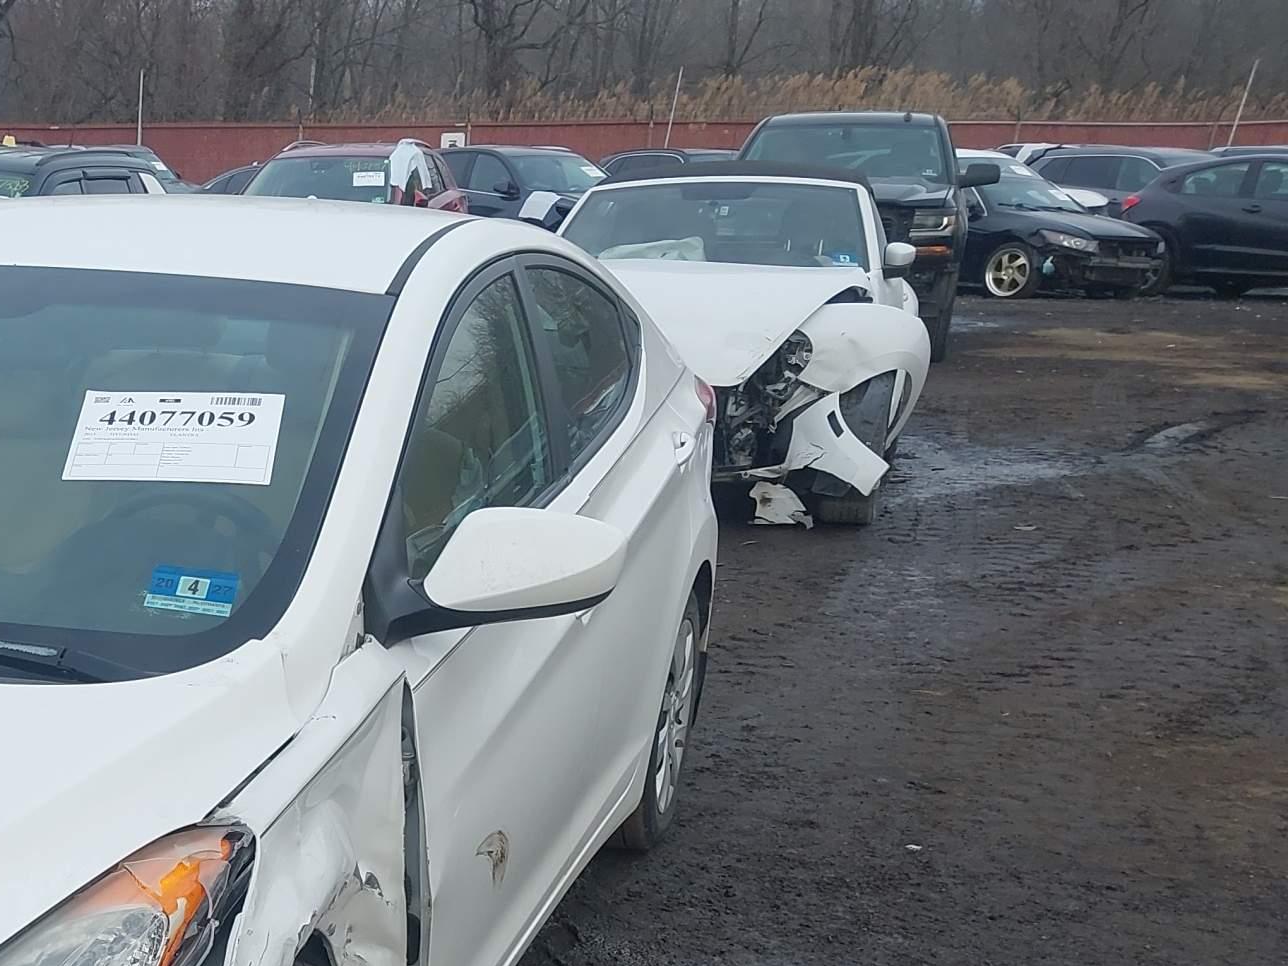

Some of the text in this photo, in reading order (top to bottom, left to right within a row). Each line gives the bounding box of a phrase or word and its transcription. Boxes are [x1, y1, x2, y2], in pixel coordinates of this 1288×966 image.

[99, 410, 255, 427] 44077059
[155, 577, 174, 588] 20
[187, 580, 201, 595] 4
[214, 586, 232, 596] 27
